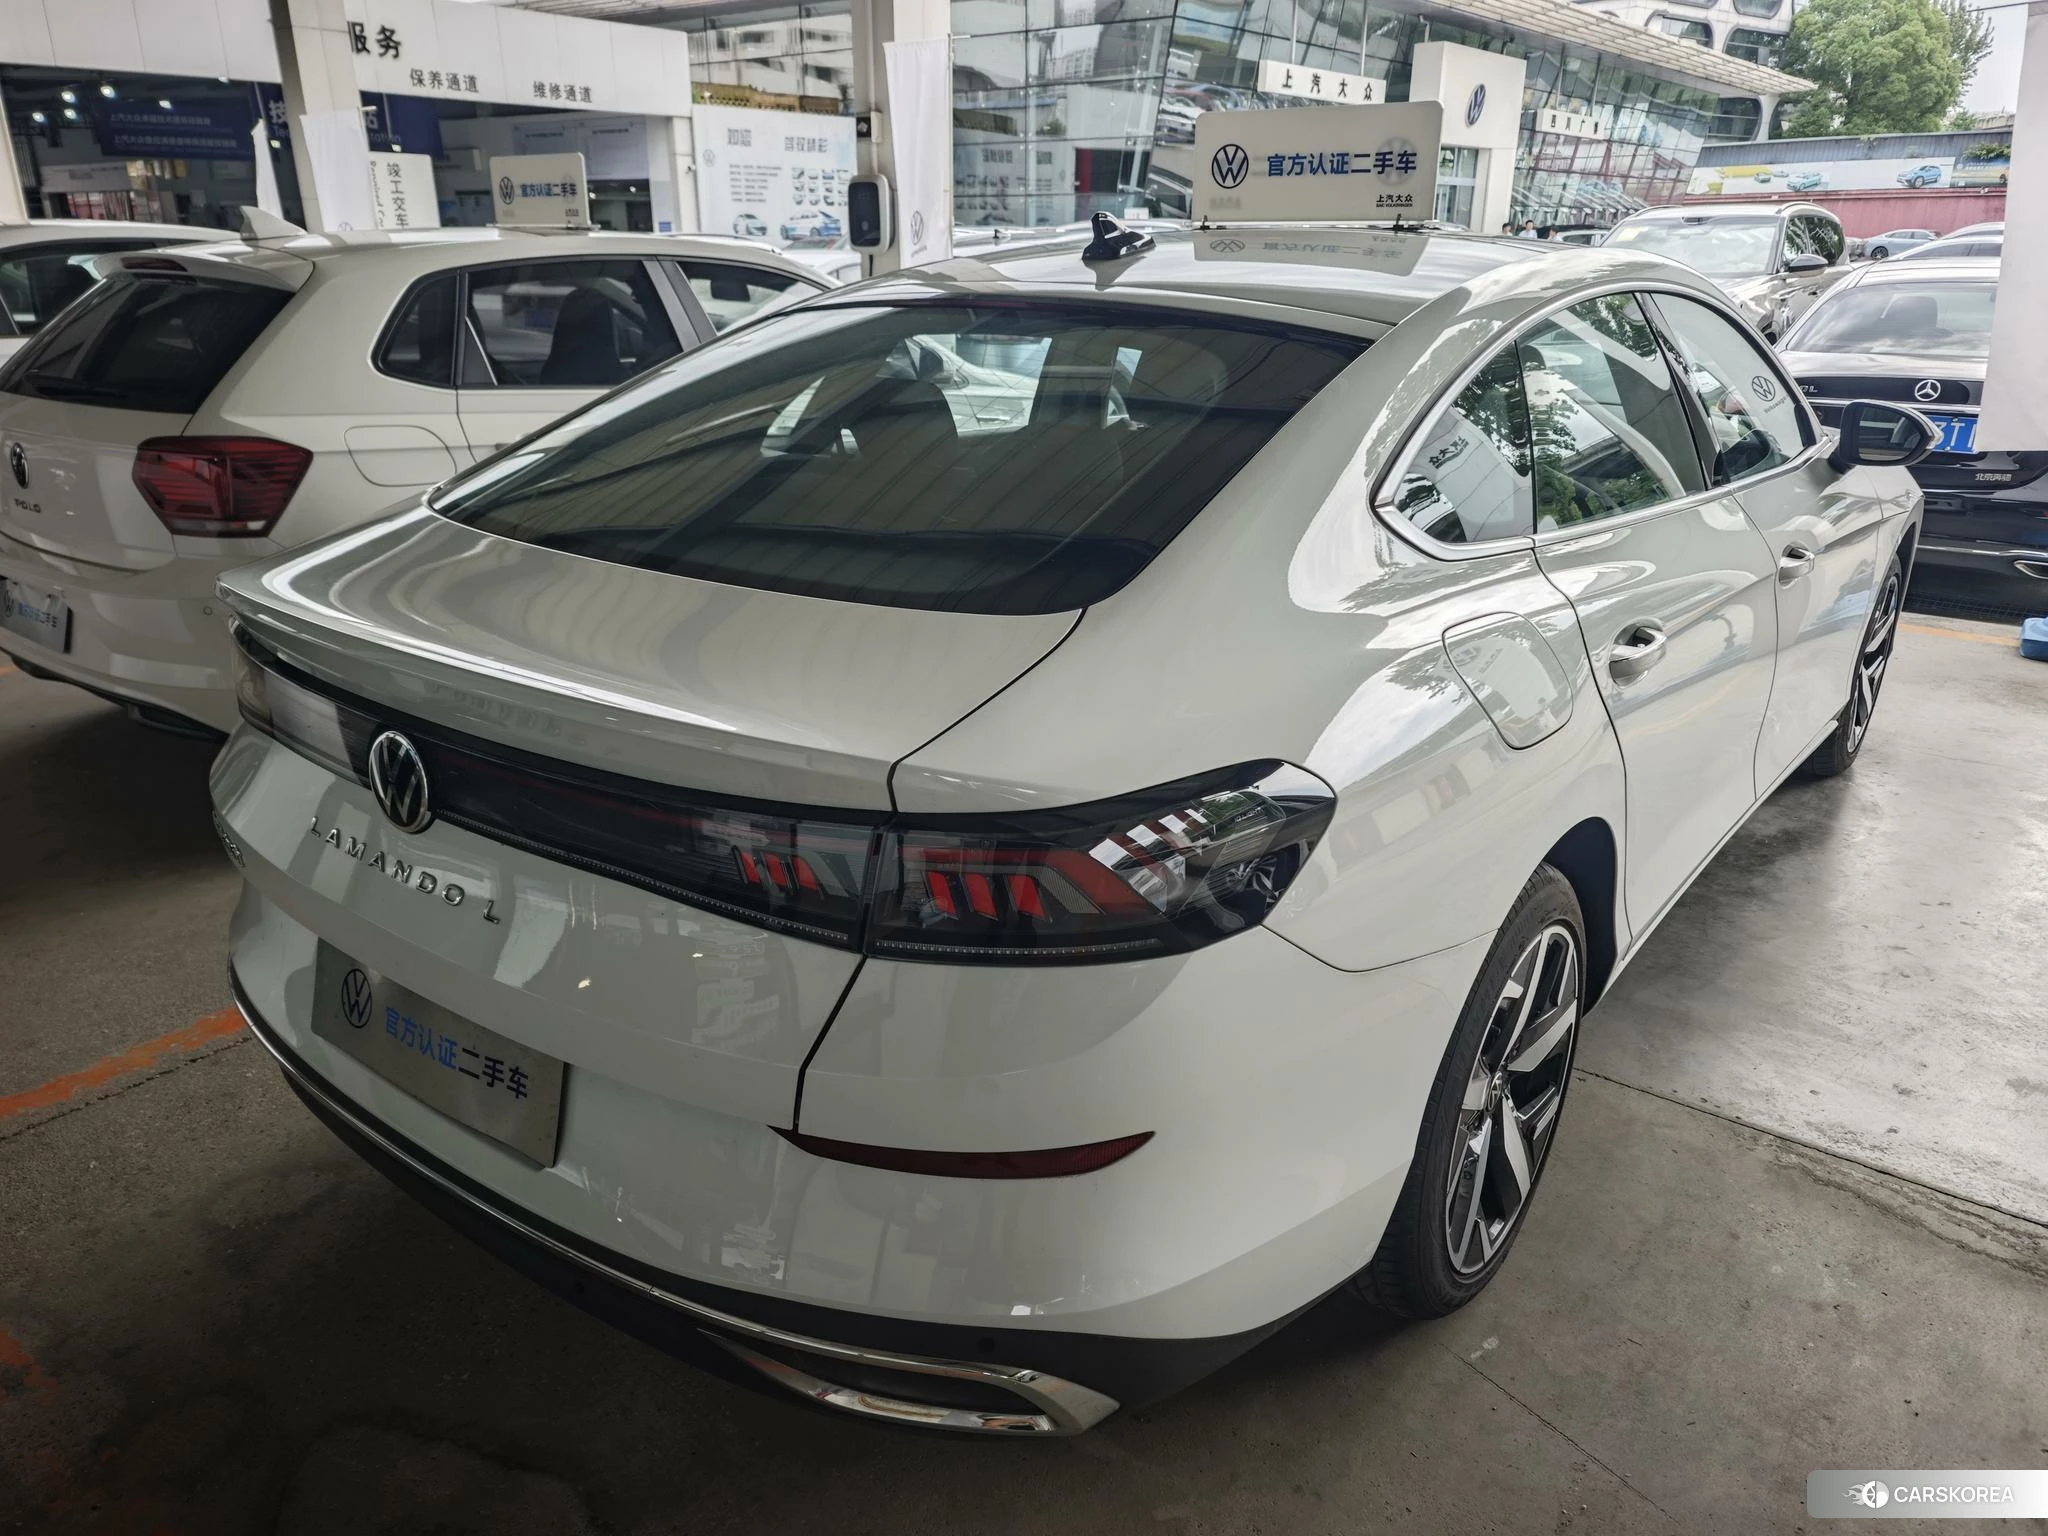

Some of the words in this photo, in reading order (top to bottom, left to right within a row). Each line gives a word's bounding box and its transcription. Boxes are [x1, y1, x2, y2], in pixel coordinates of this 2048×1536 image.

[347, 20, 401, 59] 服务
[410, 68, 479, 93] 保养通道
[533, 81, 593, 103] 维修通道
[1282, 67, 1373, 102] 上汽大众
[1267, 152, 1418, 177] 官方认证二手车
[1375, 193, 1414, 203] 上汽大众
[310, 815, 466, 907] LAMANDO
[481, 899, 502, 925] L
[384, 1006, 530, 1100] 官方认证二手车
